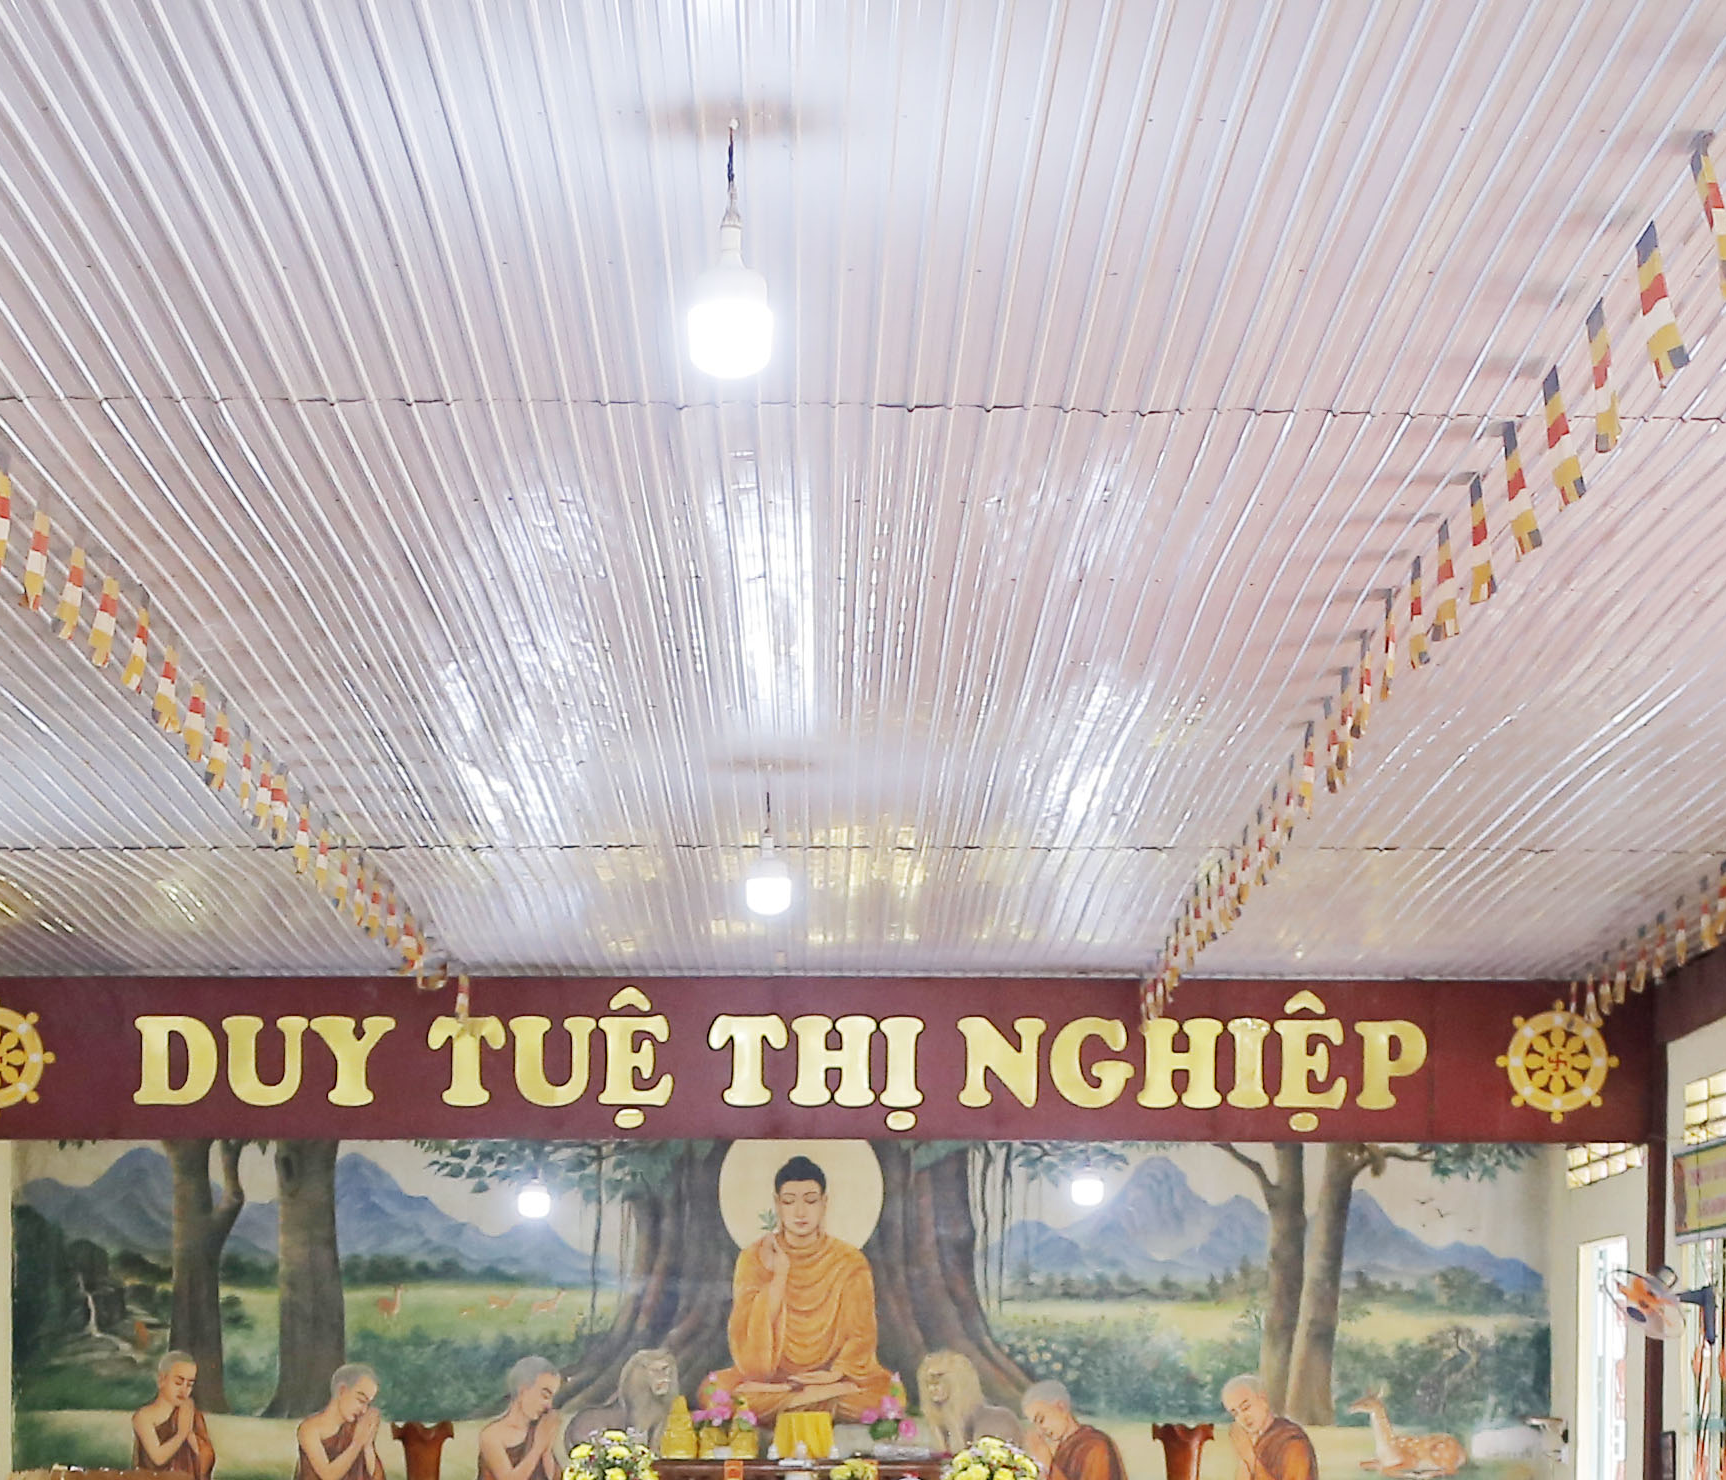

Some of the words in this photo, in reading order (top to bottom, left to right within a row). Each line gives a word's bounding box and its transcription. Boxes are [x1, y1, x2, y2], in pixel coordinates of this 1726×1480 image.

[132, 1014, 397, 1107] DUY
[426, 985, 675, 1131] TUỆ
[707, 1013, 927, 1132] THỊ
[956, 990, 1429, 1132] NGHIỆP
